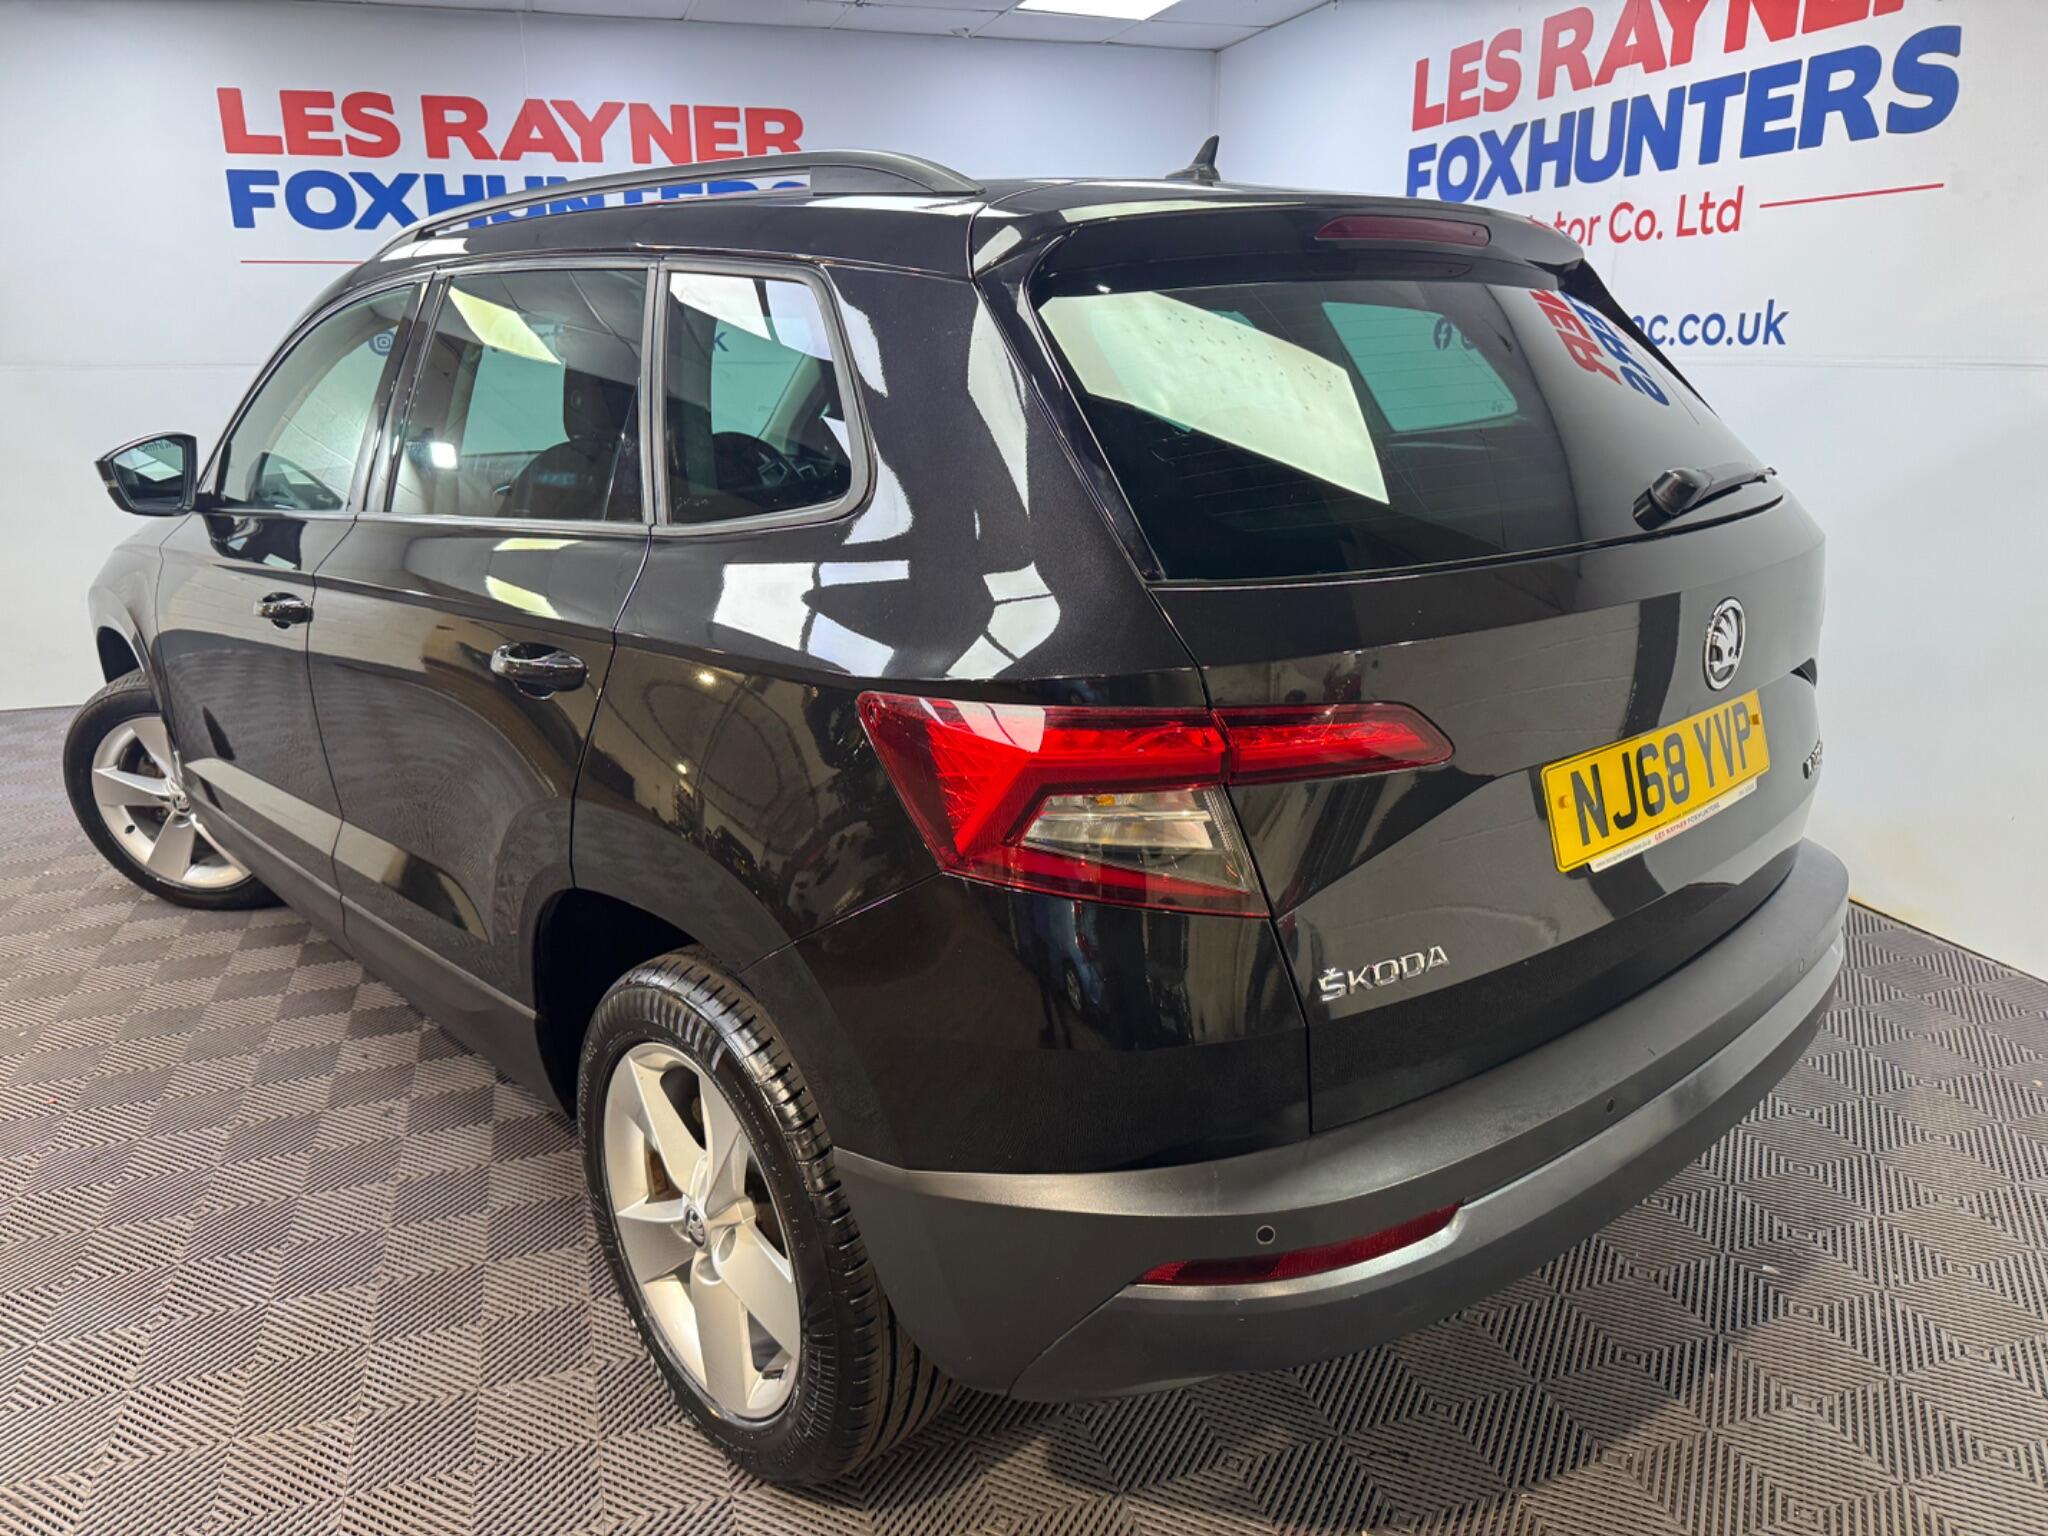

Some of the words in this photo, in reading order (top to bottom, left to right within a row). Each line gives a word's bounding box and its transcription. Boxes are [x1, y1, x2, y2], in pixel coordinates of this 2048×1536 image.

[216, 87, 401, 158] LES
[420, 94, 804, 164] RAYNER
[1406, 24, 1962, 203] FOXHUNTERS
[1411, 29, 1522, 131] LES
[1608, 201, 1663, 244] Co.
[1676, 185, 1744, 237] Ltd
[1571, 732, 1691, 847] NJ68
[1693, 701, 1751, 790] YVP
